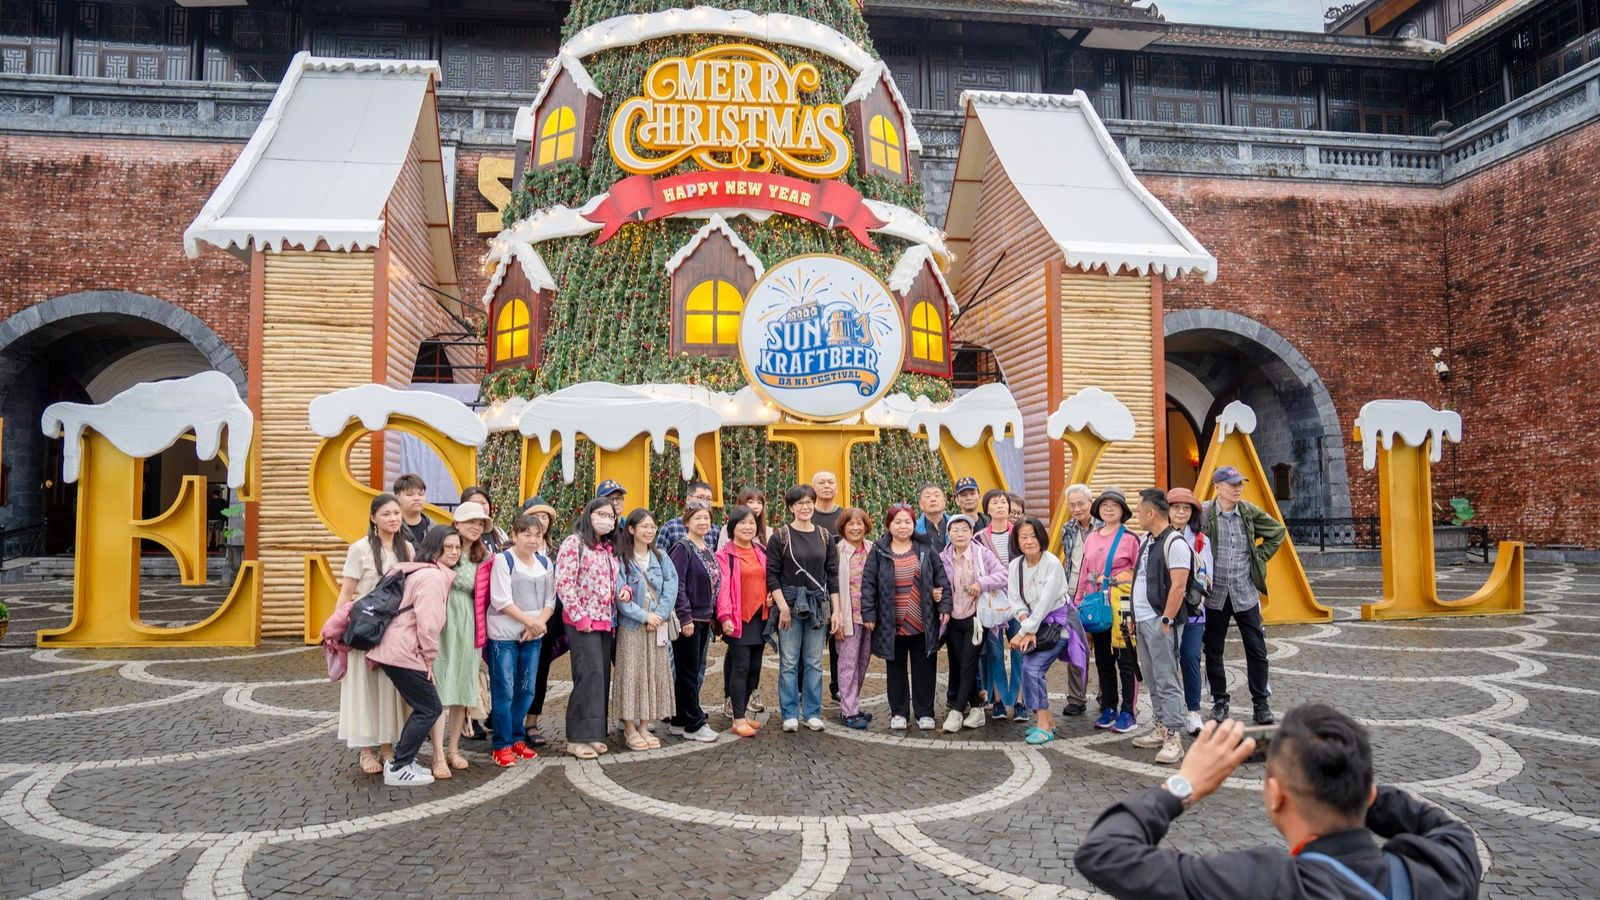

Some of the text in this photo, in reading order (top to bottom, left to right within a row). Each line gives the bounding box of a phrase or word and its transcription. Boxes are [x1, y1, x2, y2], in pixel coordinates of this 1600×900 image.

[647, 45, 820, 104] MERRY
[612, 98, 851, 173] CHRISTMAS
[663, 181, 811, 207] HAPPY NEW YEAR
[767, 319, 823, 352] SUN
[760, 345, 878, 375] KRAFTBEER
[794, 377, 808, 386] NA
[811, 370, 861, 385] FESTIVAL
